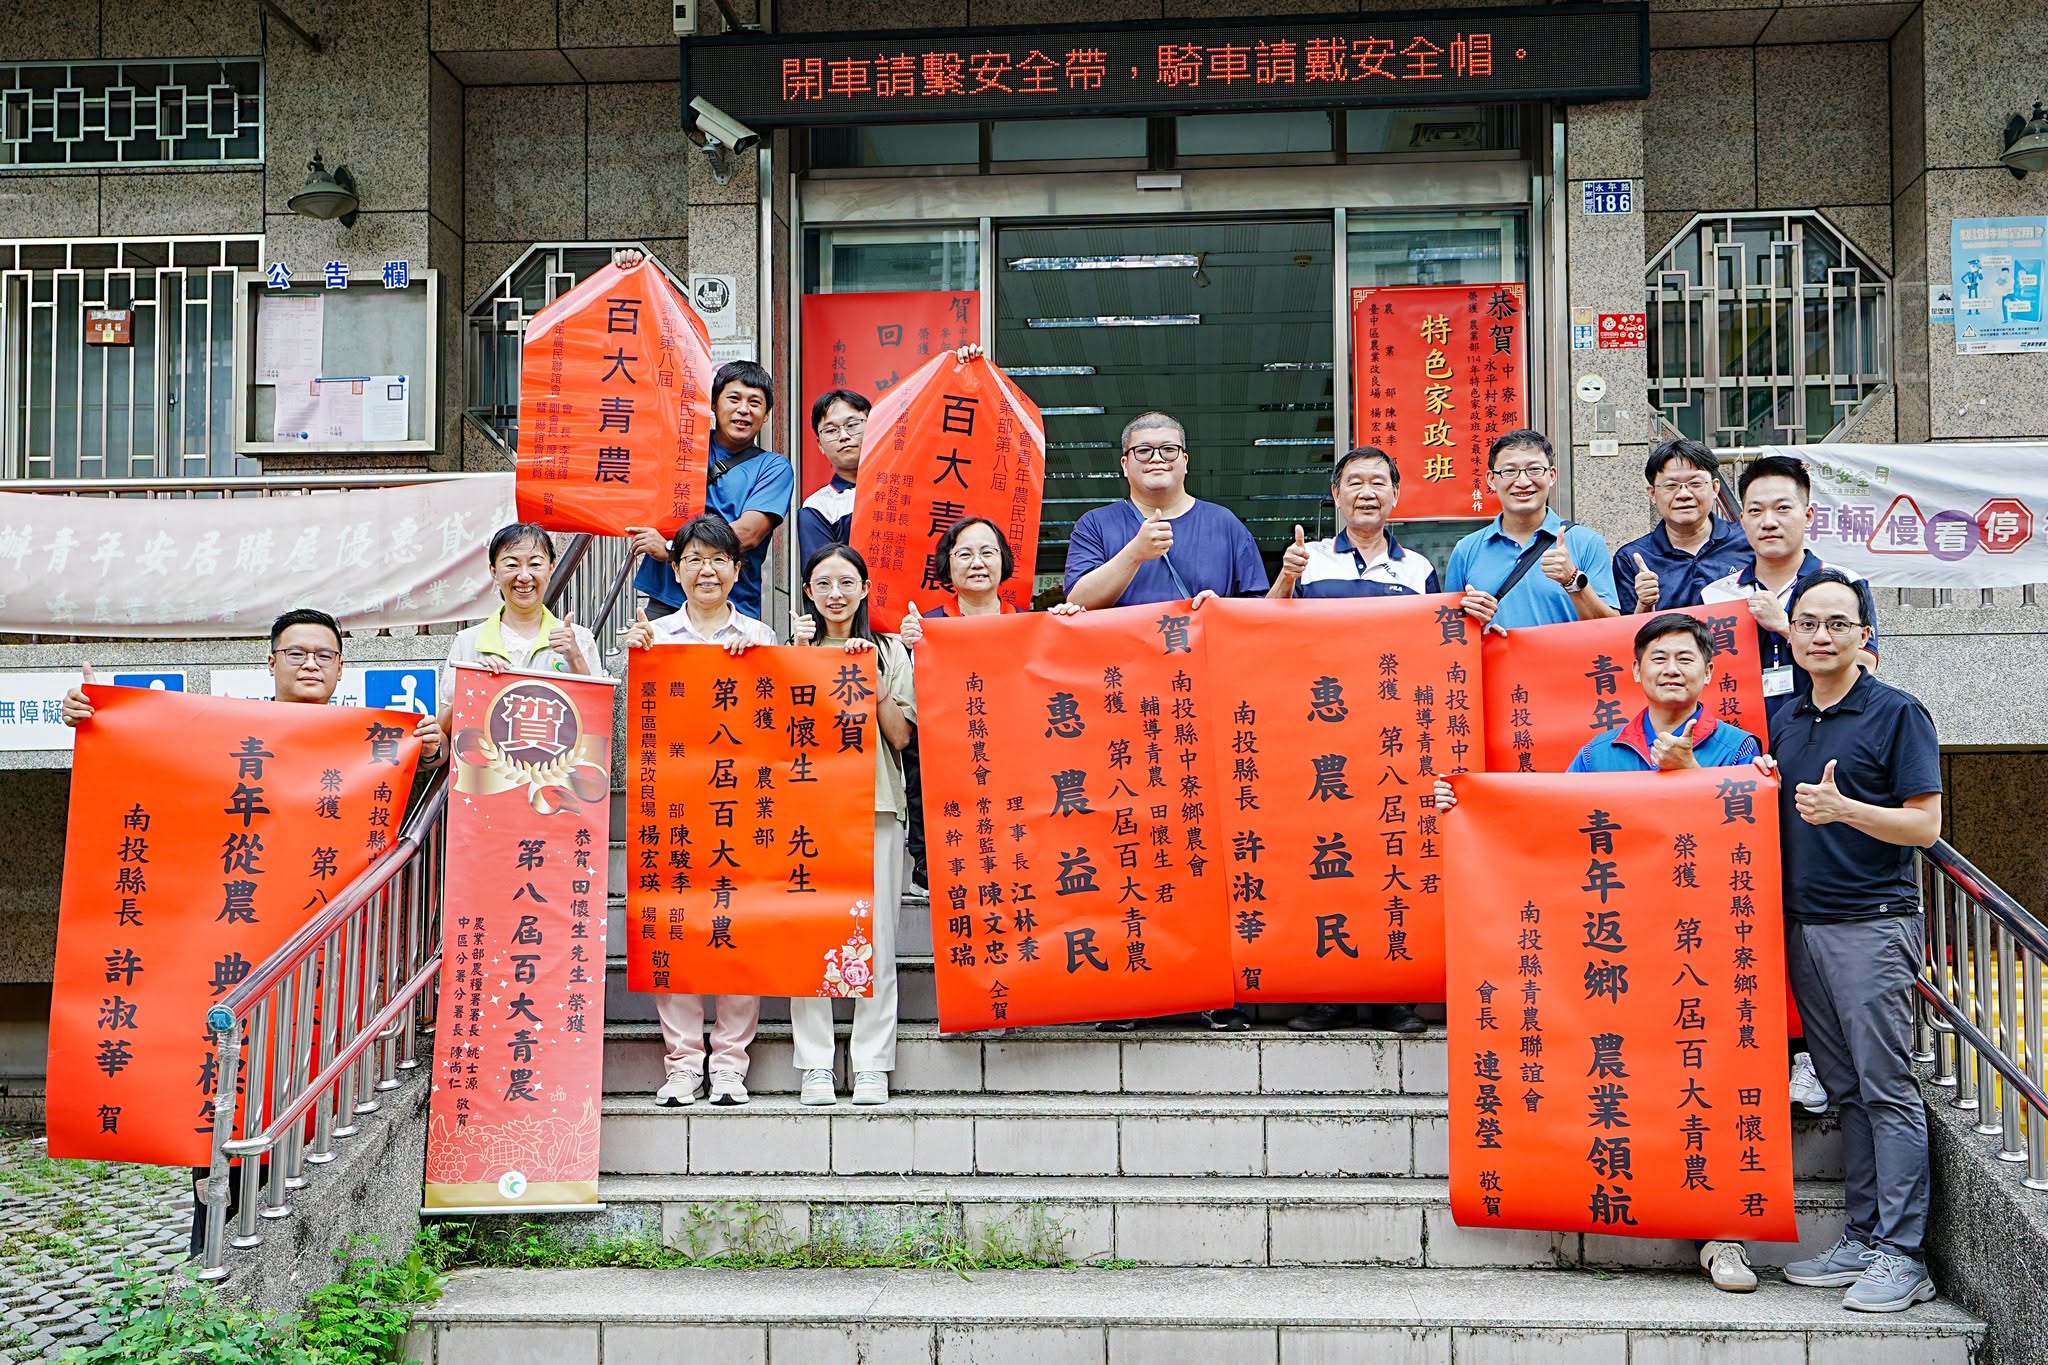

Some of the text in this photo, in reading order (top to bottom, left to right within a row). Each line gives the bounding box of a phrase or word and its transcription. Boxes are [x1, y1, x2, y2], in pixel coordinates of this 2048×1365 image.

[1596, 195, 1630, 211] 186
[267, 261, 409, 289] 公告欄
[918, 328, 931, 355] 榮獲
[950, 297, 971, 324] 賀
[1468, 291, 1479, 313] 榮獲
[594, 298, 642, 484] 百大青農
[832, 339, 847, 385] 南投縣
[1369, 304, 1382, 446] 臺中區農業改良場 楊宏瑛
[1385, 408, 1397, 446] 陳駿季
[1420, 313, 1458, 483] 特色家政班
[1486, 291, 1518, 427] 恭賀 中寮鄉
[886, 473, 901, 523] 常務監事
[1472, 489, 1484, 512] 佳作
[876, 583, 888, 608] 敬賀
[1157, 614, 1192, 656] 賀
[1434, 604, 1469, 647] 賀
[366, 721, 405, 766] 賀
[500, 693, 567, 756] 賀
[829, 663, 875, 754] 恭賀
[965, 670, 992, 788] 南投縣農會
[1445, 661, 1471, 774] 南投縣中
[1509, 683, 1537, 773] 南投縣農
[1584, 654, 1630, 731] 青年
[215, 734, 274, 925] 青年從農
[315, 768, 344, 820] 榮獲
[637, 681, 662, 941] 臺中區農業改良場 楊宏瑛 場長
[706, 677, 744, 950] 第八屆百大青農
[752, 677, 777, 850] 榮獲 農業部
[786, 684, 820, 894] 田懷生 先生
[1043, 690, 1110, 975] 惠農益民
[1102, 665, 1153, 975] 榮獲 第八屆百大青農
[1139, 695, 1177, 905] 輔導青農 田懷生 君
[1171, 669, 1209, 878] 南投縣中寮鄉農會
[1306, 675, 1360, 961] 惠農益民
[1376, 652, 1414, 963] 榮獲 第八屆百大青農
[1413, 684, 1441, 895] 輔導青農 田懷生 君
[1715, 777, 1758, 825] 賀
[668, 824, 693, 895] 陳駿季
[942, 800, 977, 969] 總幹事 曾明瑞
[975, 796, 1010, 967] 常務監事 陳文忠
[1006, 795, 1031, 873] 理事長
[1230, 699, 1268, 992] 南投縣長 許淑華 賀
[95, 802, 152, 1135] 南投縣長 許淑華 賀
[503, 839, 549, 1102] 第八屆百大青農
[567, 828, 592, 1034] 恭賀 田懷生先生 榮獲
[652, 950, 671, 989] 敬賀
[668, 907, 684, 941] 部長
[448, 916, 470, 1090] 中區分署分署長 陳尚仁
[1516, 899, 1545, 1114] 南投縣青農聯誼會
[1578, 807, 1639, 1227] 青年返鄉 農業領航
[1671, 832, 1716, 1192] 榮獲 第八屆百大青農
[1728, 841, 1769, 1218] 南投縣中寮鄉青農 田懷生 君
[456, 1098, 470, 1128] 敬賀
[1473, 979, 1504, 1218] 會長 連晏瑩 敬賀
